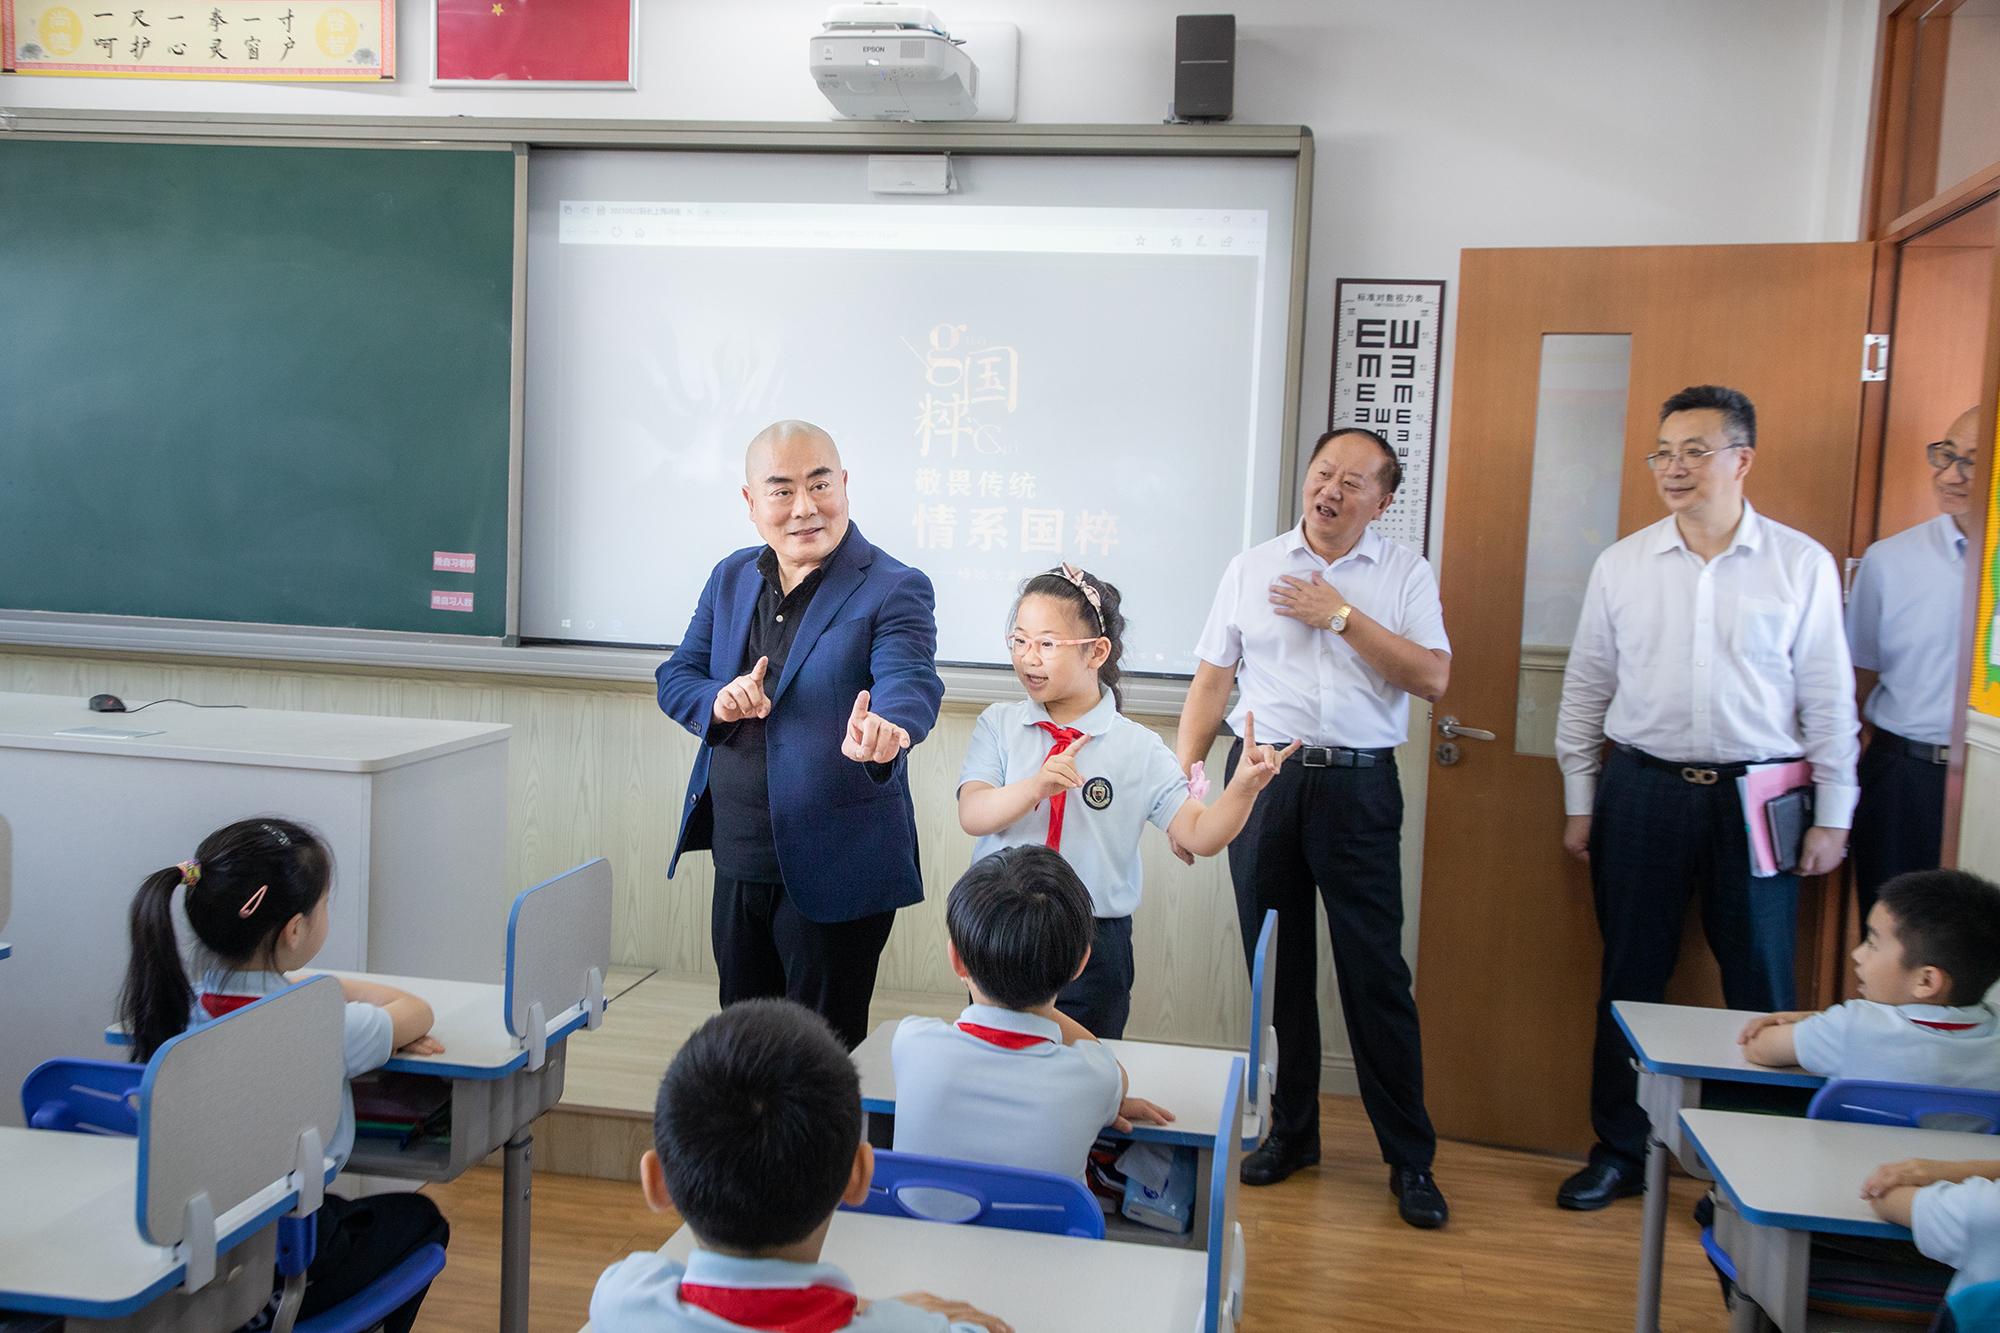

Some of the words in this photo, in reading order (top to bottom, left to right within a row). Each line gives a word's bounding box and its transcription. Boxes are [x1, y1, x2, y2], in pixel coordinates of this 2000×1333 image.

[93, 8, 295, 33] 一尺一拳一寸
[94, 35, 296, 62] 呵护心灵窗户
[1357, 293, 1424, 303] 标准对数视力表
[915, 467, 1037, 499] 敬畏传统
[913, 503, 1120, 557] 情系国粹
